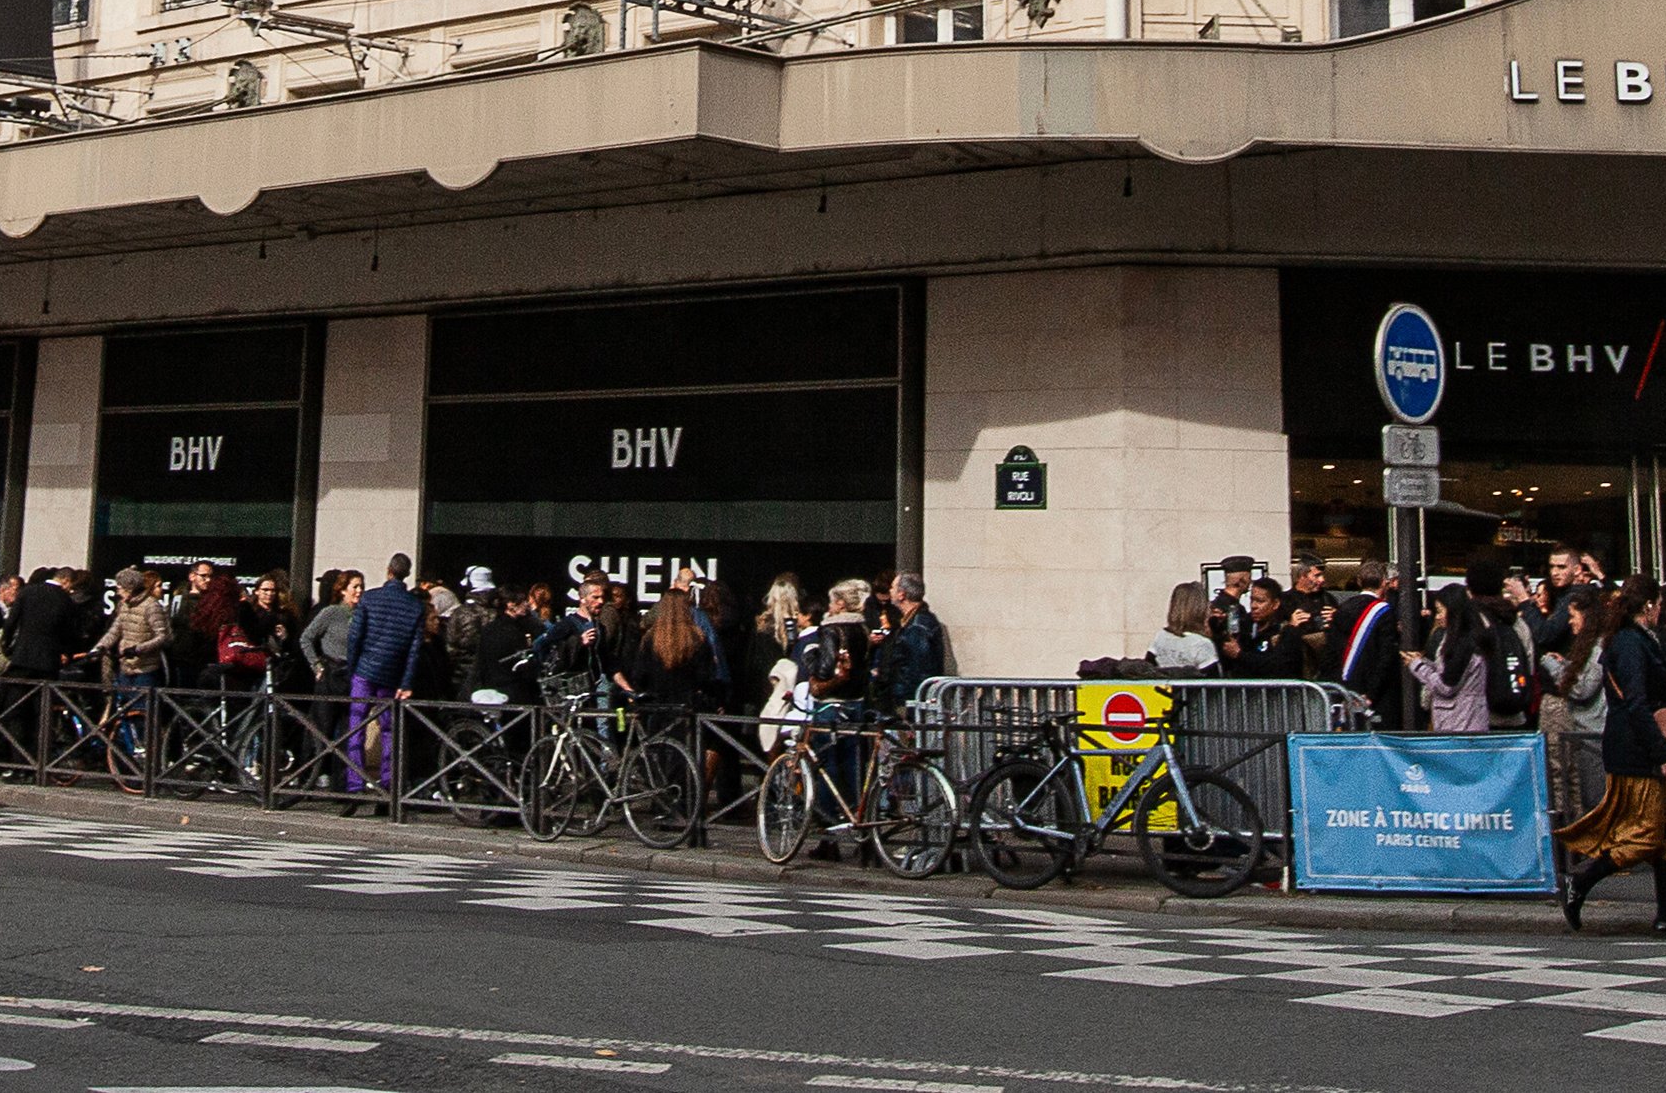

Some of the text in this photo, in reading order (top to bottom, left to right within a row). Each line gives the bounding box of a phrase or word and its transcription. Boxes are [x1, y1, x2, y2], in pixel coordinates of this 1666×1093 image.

[1509, 60, 1586, 102] LE
[1456, 342, 1507, 370] LE
[1530, 344, 1628, 373] BHV
[170, 436, 222, 470] BHV
[612, 427, 682, 468] BHV
[1011, 471, 1030, 482] RUE
[1326, 805, 1514, 831] ZONE À TRAFIC LIMITÉ
[1376, 833, 1461, 849] PARIS CENTRE
